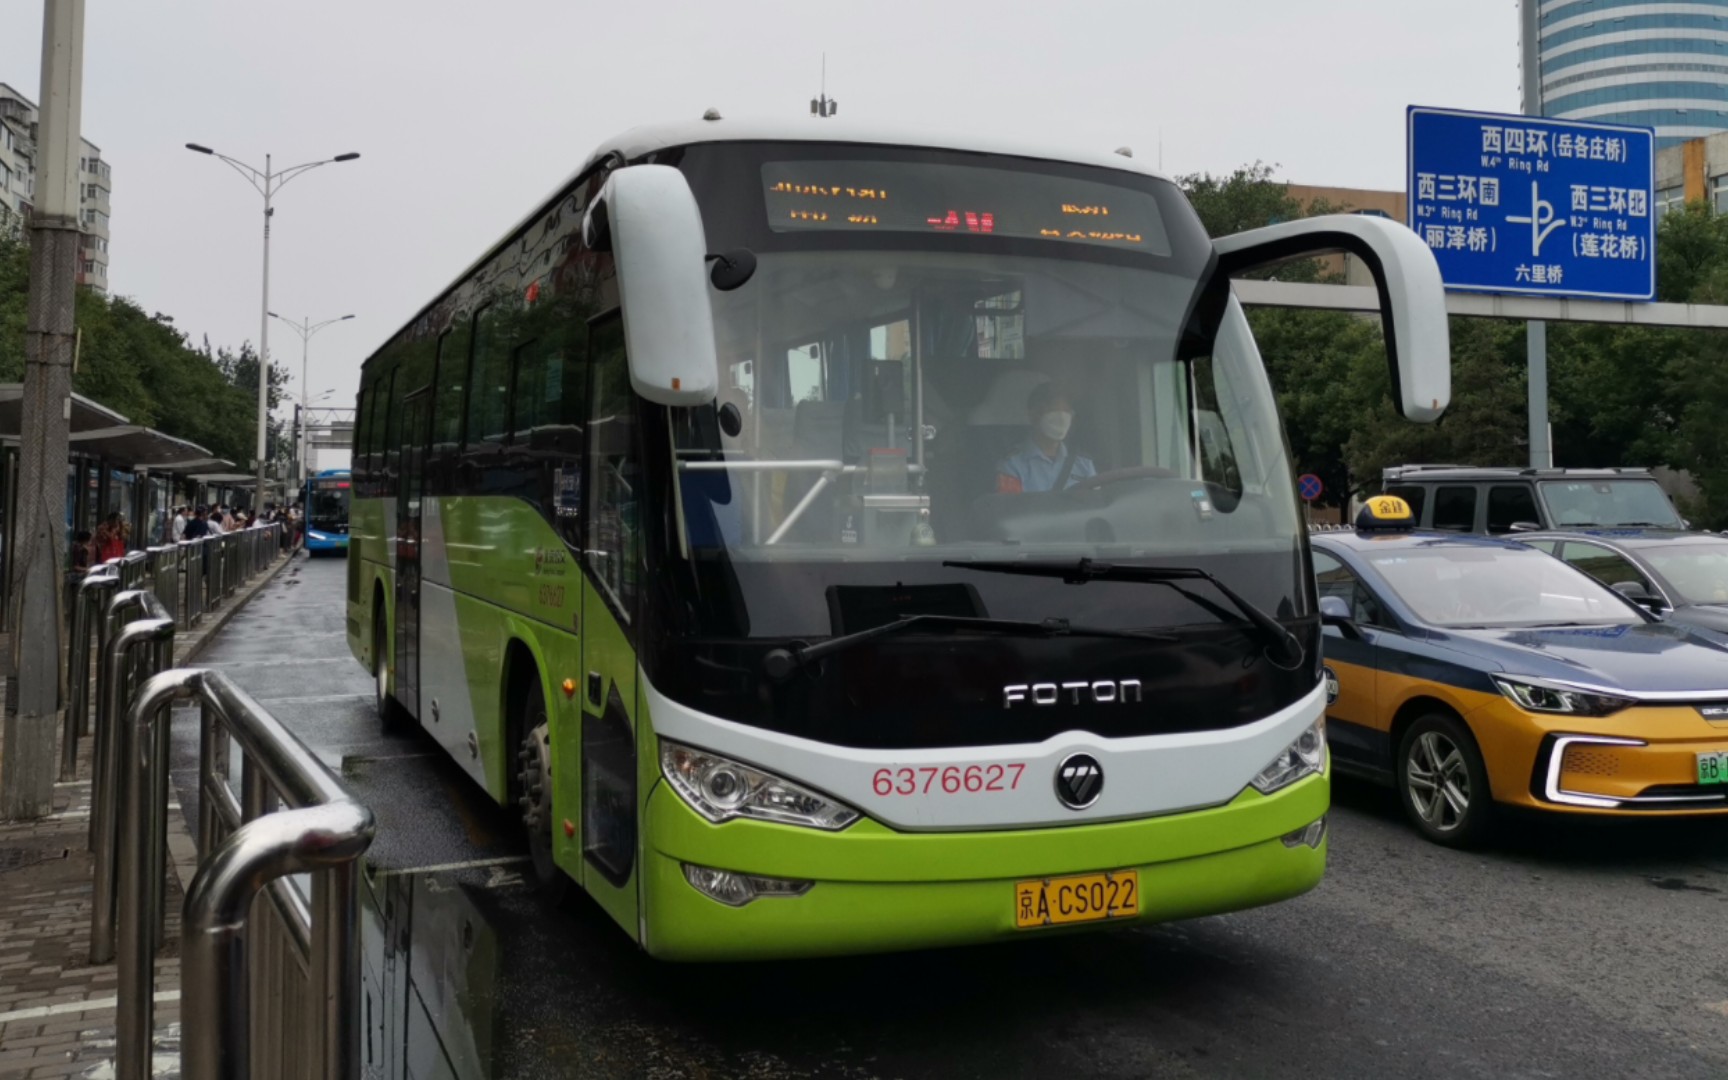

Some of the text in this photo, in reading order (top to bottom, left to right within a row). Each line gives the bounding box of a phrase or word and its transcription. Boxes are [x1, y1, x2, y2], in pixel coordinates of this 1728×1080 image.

[1508, 157, 1532, 174] Ring
[1536, 159, 1549, 173] Rd
[1417, 172, 1499, 206] 西三环南
[1570, 184, 1647, 217] 西三环北
[1441, 206, 1462, 223] Ring
[1466, 208, 1478, 221] Rd
[1593, 217, 1613, 233] Ring
[1617, 219, 1627, 231] Rd
[1572, 232, 1646, 261] (莲花桥)
[1515, 263, 1563, 284] 六里桥
[1003, 679, 1142, 709] FOTON
[872, 762, 1027, 797] 6376627
